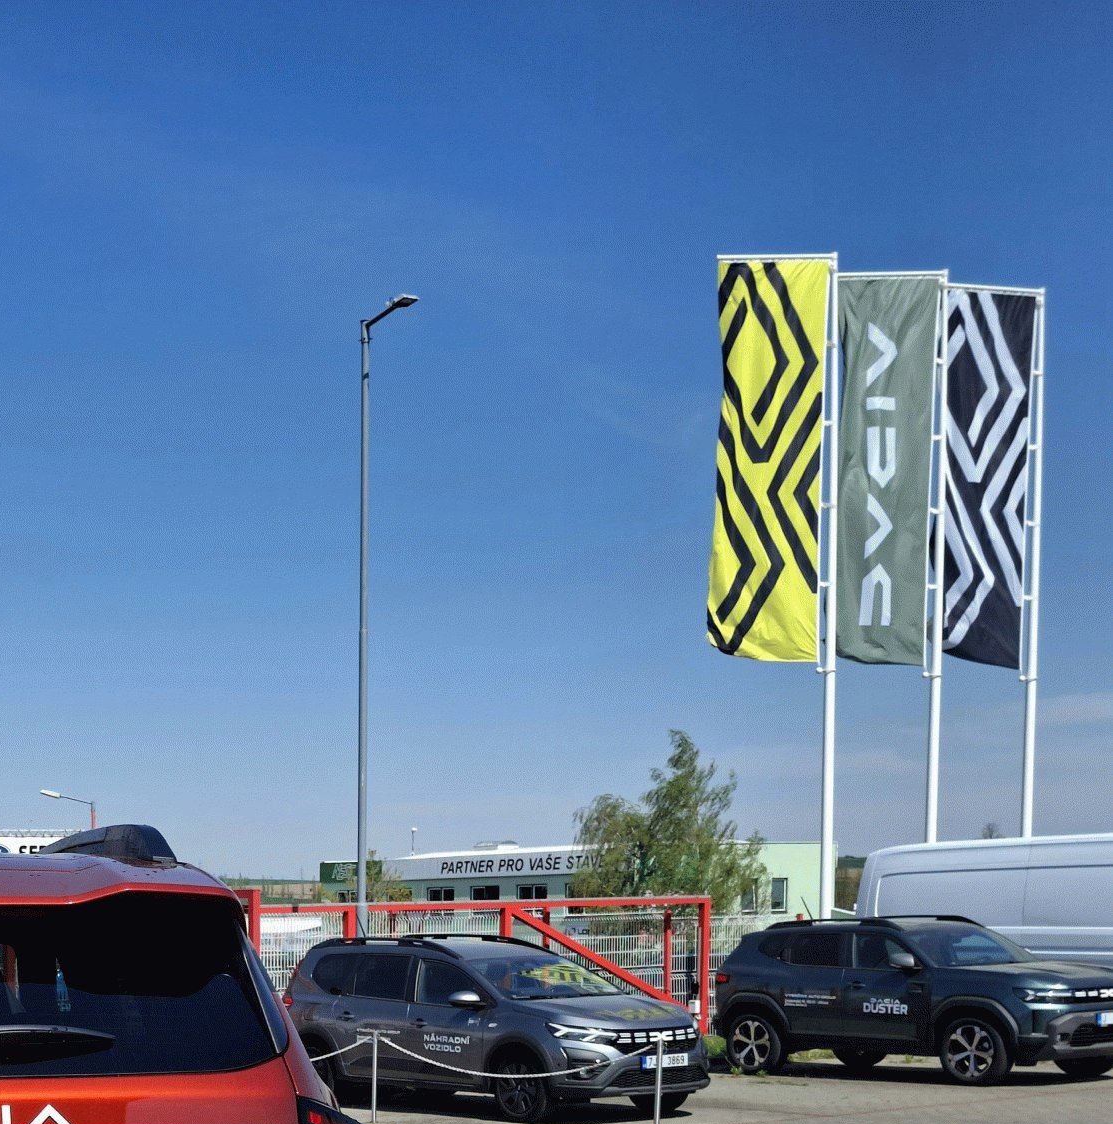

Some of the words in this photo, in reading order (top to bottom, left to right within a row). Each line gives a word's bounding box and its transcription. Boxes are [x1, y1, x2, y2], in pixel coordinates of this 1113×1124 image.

[441, 860, 494, 874] PARTNER
[498, 858, 524, 872] PRO
[529, 854, 561, 870] VAŠE
[863, 1002, 908, 1015] DUSTER
[423, 1033, 470, 1045] NÁHRADNÍ
[424, 1043, 462, 1053] VOZIDLO
